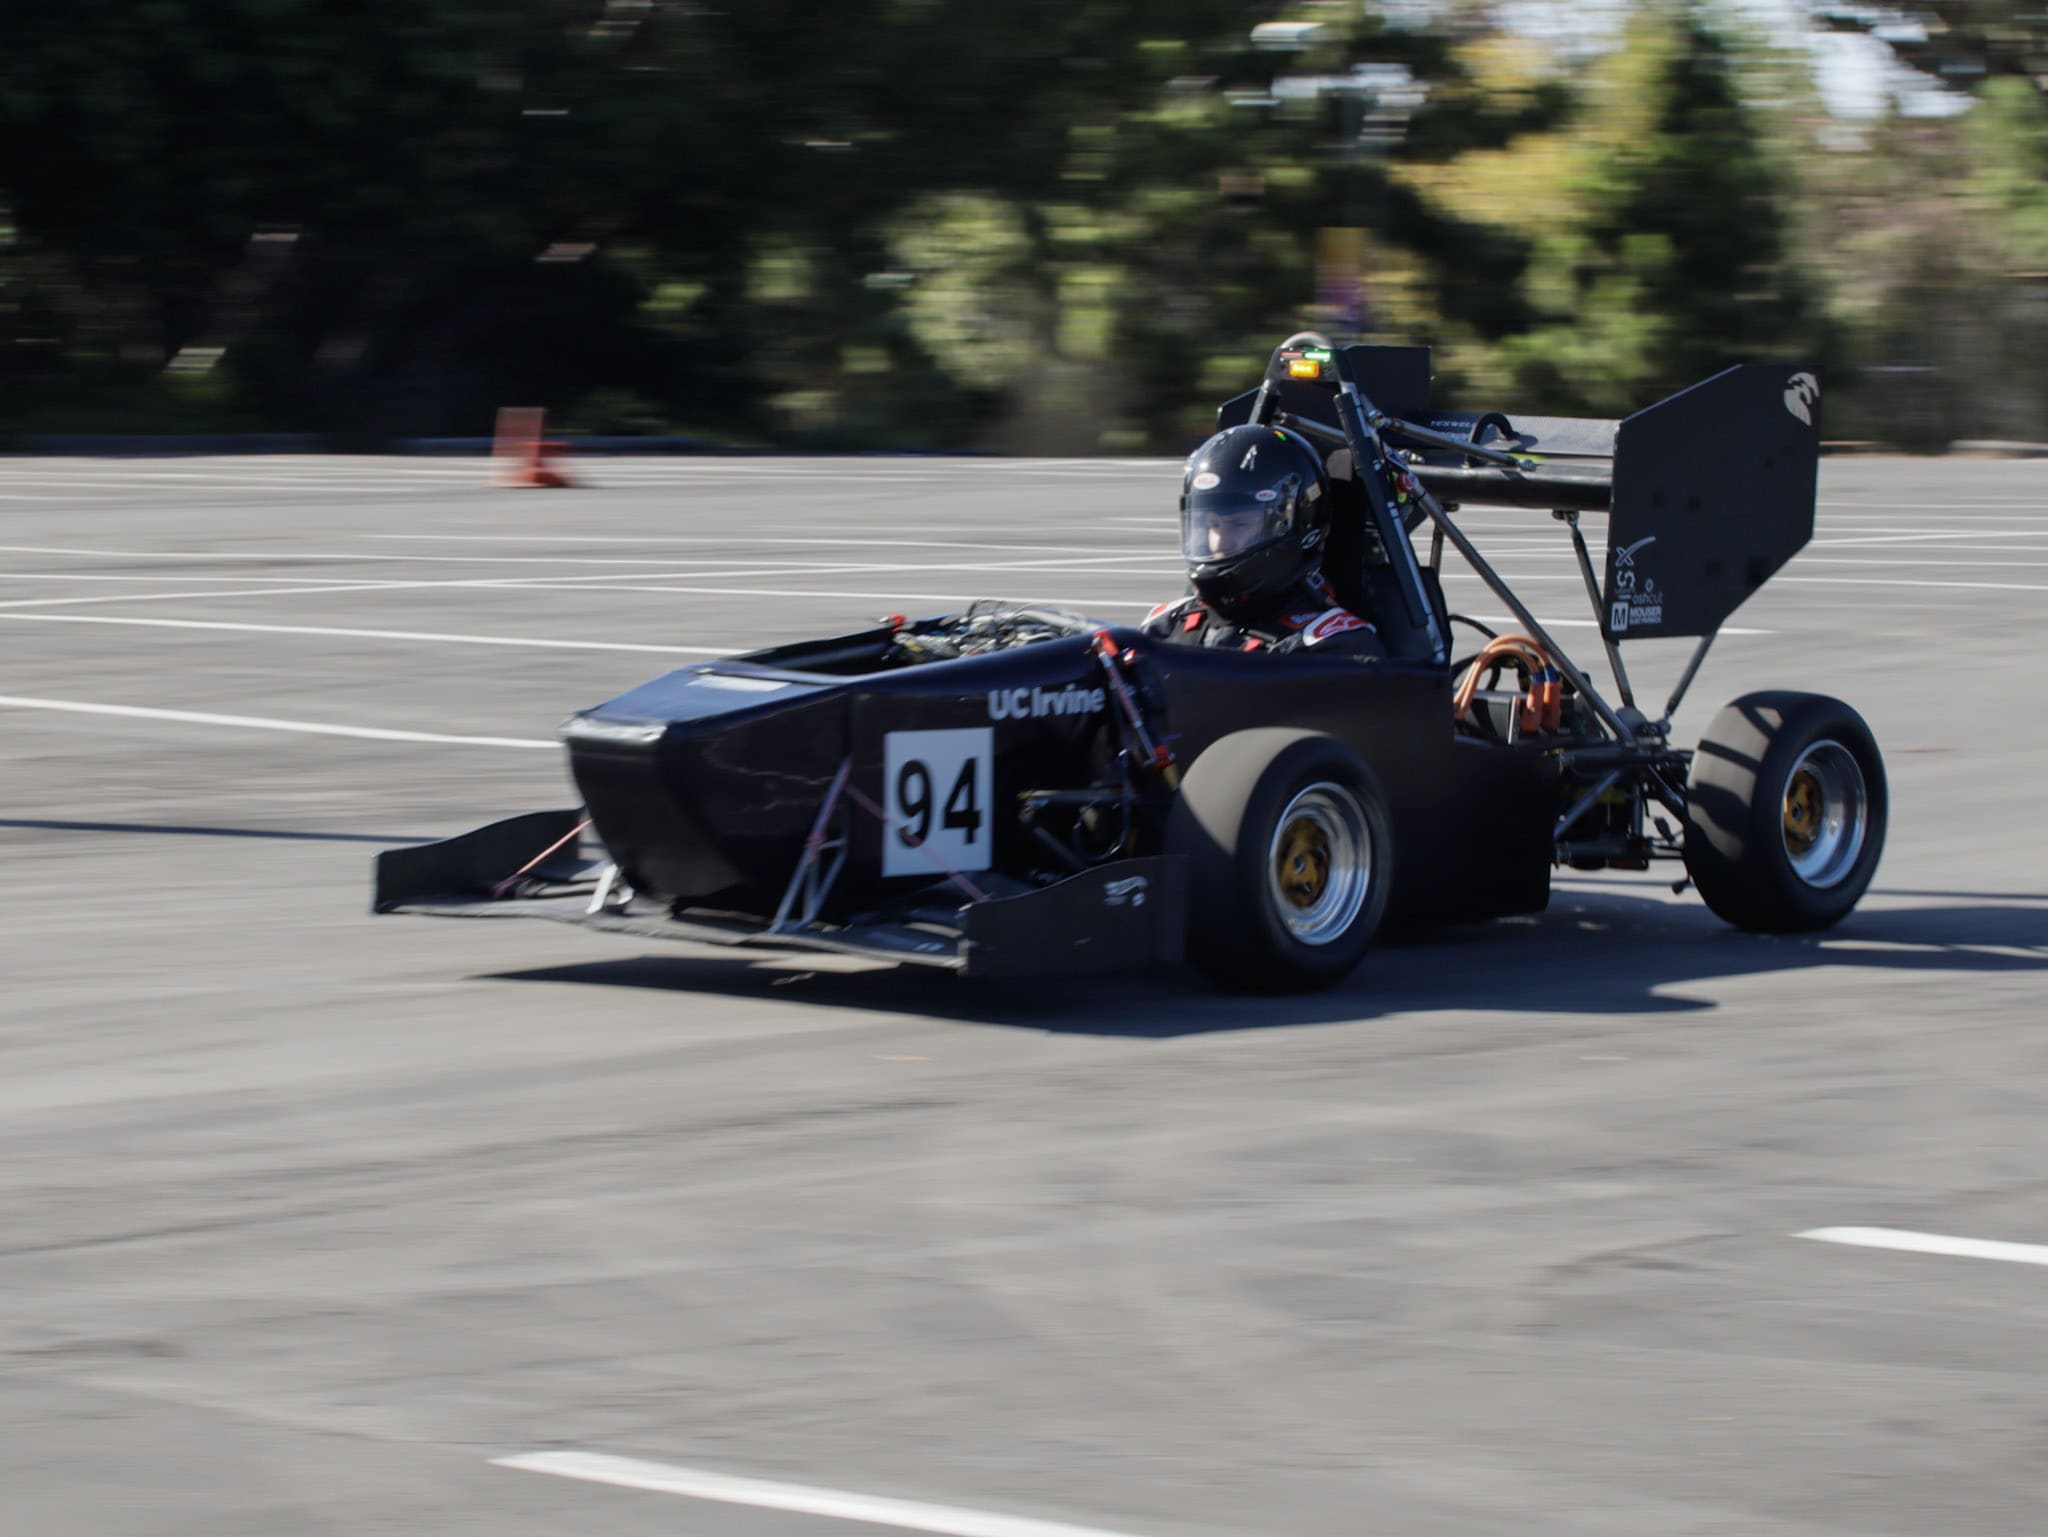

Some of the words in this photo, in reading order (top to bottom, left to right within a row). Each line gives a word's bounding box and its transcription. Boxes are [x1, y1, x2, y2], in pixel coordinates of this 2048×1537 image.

[988, 687, 1030, 721] UC
[1031, 683, 1105, 718] Irvine
[897, 757, 982, 849] 94
